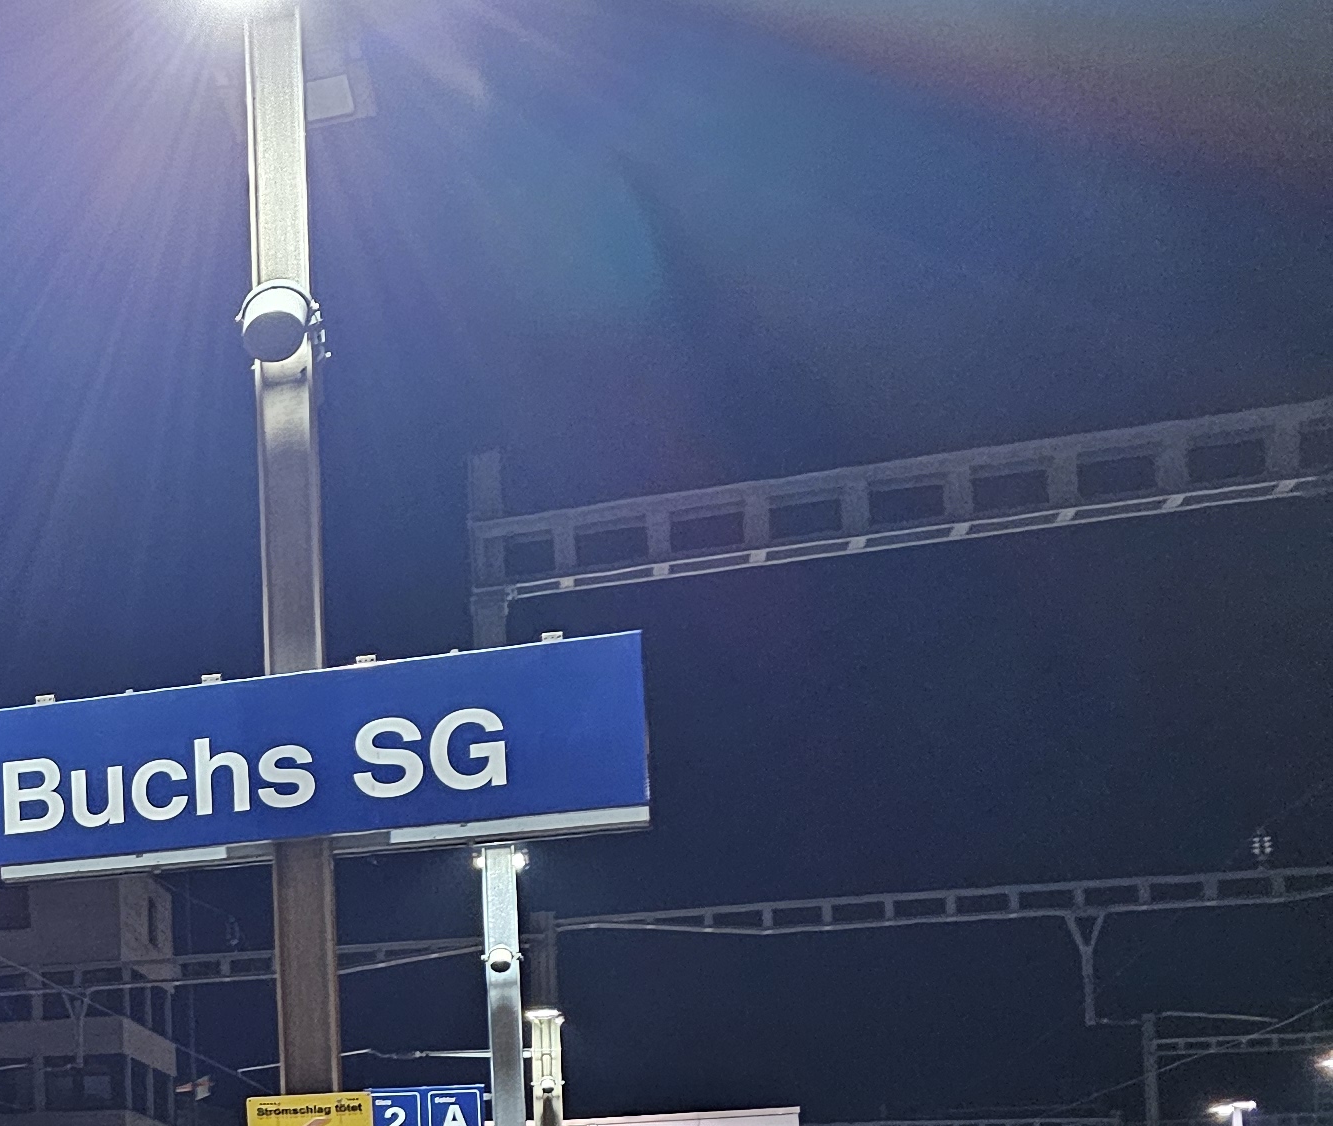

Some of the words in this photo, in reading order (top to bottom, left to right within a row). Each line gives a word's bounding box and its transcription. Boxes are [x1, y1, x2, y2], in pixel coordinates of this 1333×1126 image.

[2, 736, 316, 836] Buchs
[352, 707, 509, 799] SG
[256, 1105, 332, 1117] Stromschlag
[334, 1102, 363, 1113] tötet
